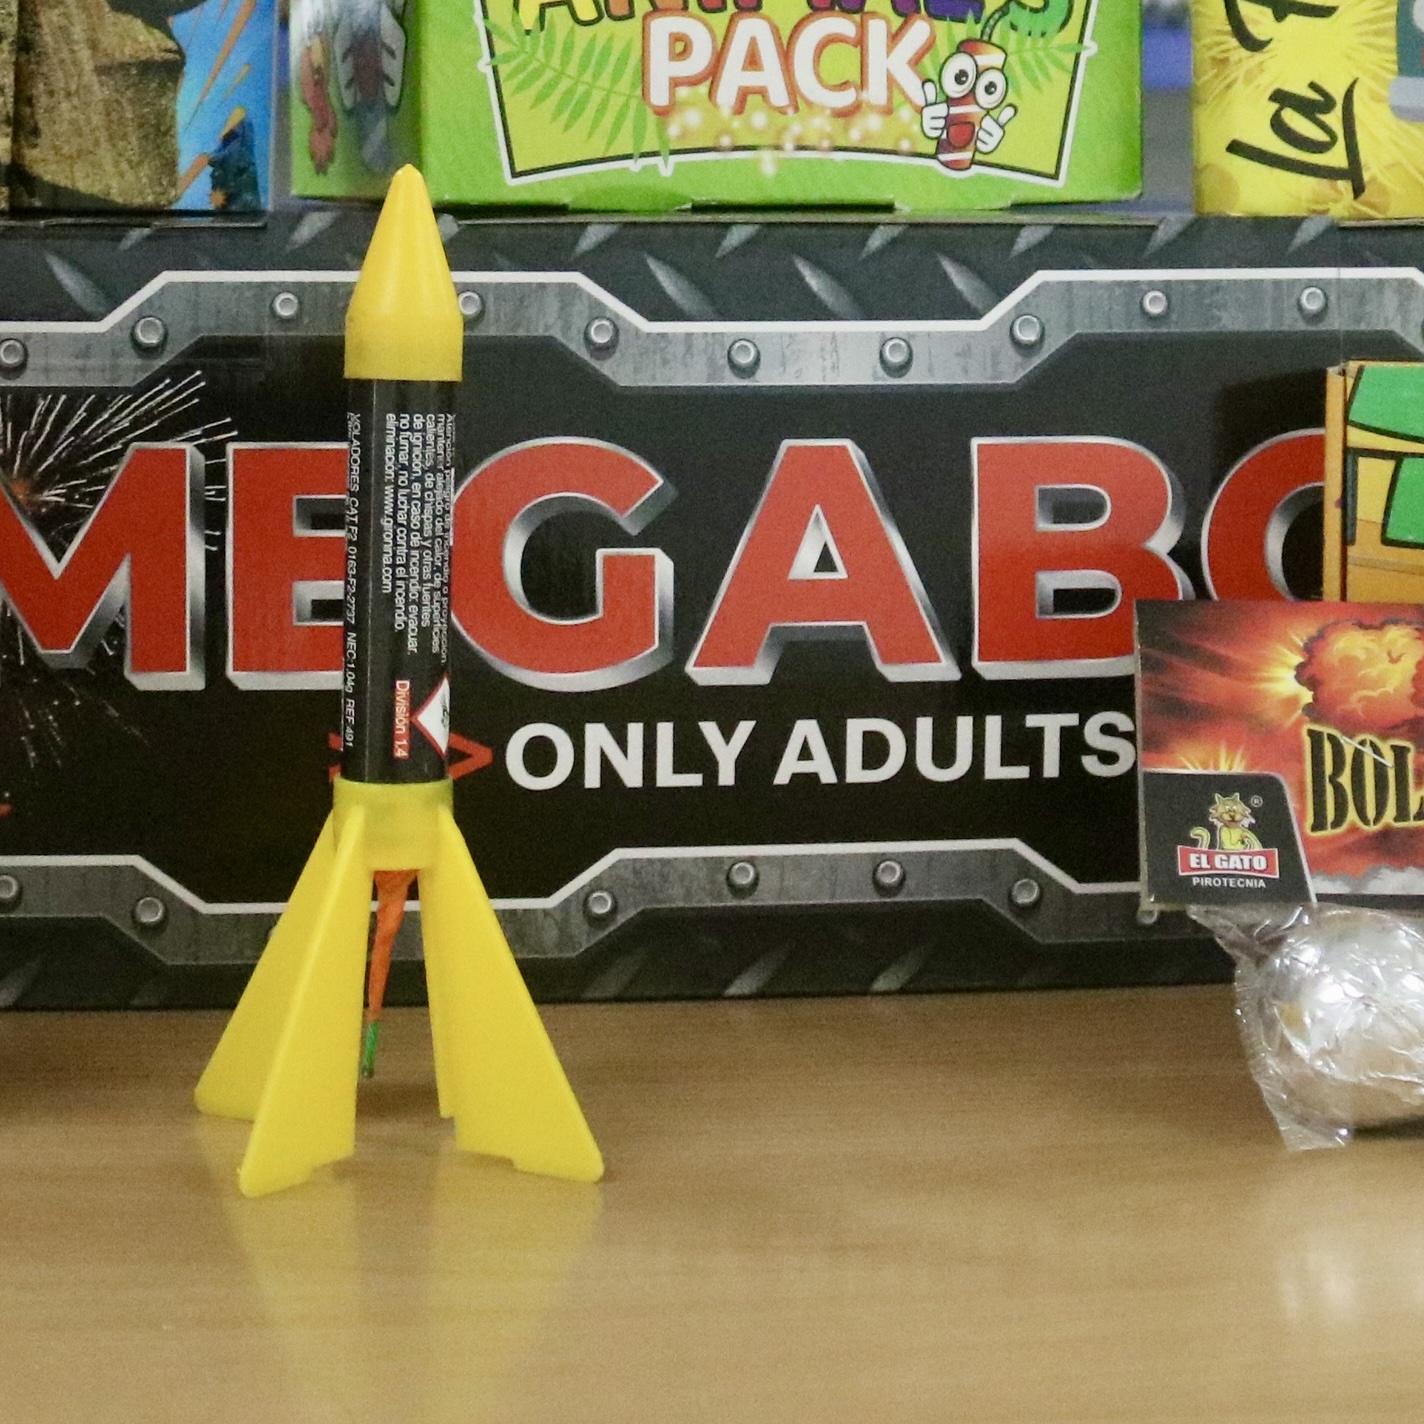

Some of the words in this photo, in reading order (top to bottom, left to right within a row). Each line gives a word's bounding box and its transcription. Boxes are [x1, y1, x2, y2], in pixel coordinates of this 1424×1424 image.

[641, 11, 936, 116] PACK
[1227, 78, 1365, 201] La
[399, 414, 410, 429] no
[413, 414, 424, 430] de
[398, 471, 408, 486] no
[411, 482, 421, 498] en
[425, 473, 434, 488] de
[434, 473, 444, 514] alejado
[349, 497, 359, 523] CAT
[397, 489, 409, 524] luchar
[410, 500, 421, 529] caso
[421, 491, 434, 536] chispas
[348, 525, 358, 541] F2
[435, 518, 444, 535] del
[396, 527, 408, 564] contra
[410, 531, 422, 547] de
[395, 567, 407, 578] el
[422, 550, 432, 579] otras
[433, 573, 442, 588] de
[421, 583, 431, 627] fuentes
[431, 591, 441, 654] superficies
[395, 680, 410, 734] División
[395, 738, 408, 758] 1.4
[505, 719, 757, 792] ONLY
[772, 711, 1137, 787] ADULTS
[1188, 852, 1213, 872] EL
[1214, 851, 1269, 874] GATO
[1190, 875, 1268, 891] PIROTECNIA
